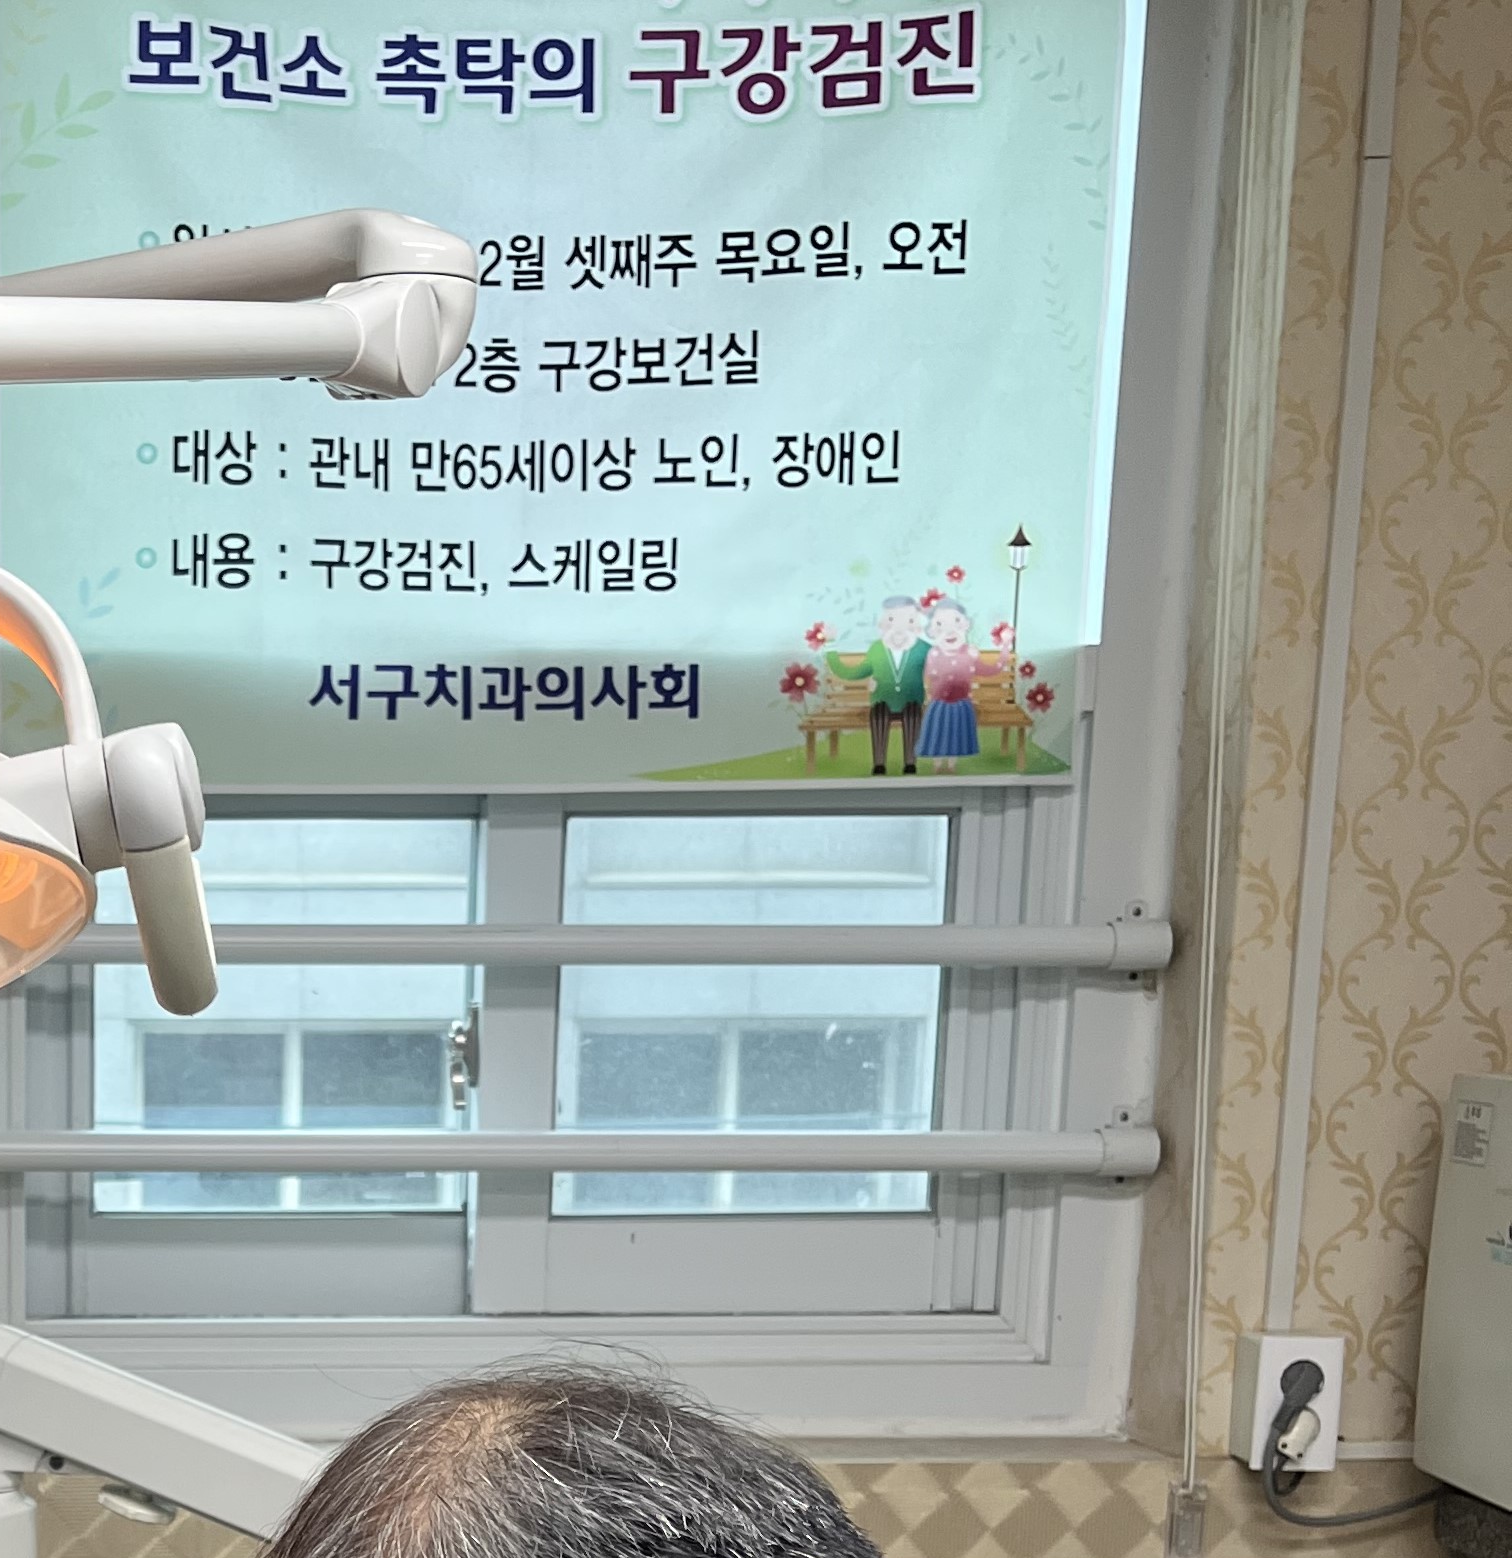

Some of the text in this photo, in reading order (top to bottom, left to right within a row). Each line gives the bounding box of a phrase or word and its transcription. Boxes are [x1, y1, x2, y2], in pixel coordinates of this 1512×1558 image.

[128, 9, 976, 115] 보건소 촉탁의 구강검진
[565, 233, 697, 290] 셋째주
[716, 221, 863, 284] 목요일,
[882, 219, 968, 275] 오전
[454, 329, 759, 394] 2층 구강보건실
[172, 429, 257, 486] 대상
[309, 436, 390, 492] 관내
[411, 437, 637, 493] 만65세이상
[654, 433, 750, 491] 노인,
[772, 429, 900, 488] 장애인
[172, 532, 256, 589] 내용
[309, 538, 488, 596] 구강검진,
[508, 537, 679, 593] 스케일링
[307, 663, 701, 722] 서구치과의사회
